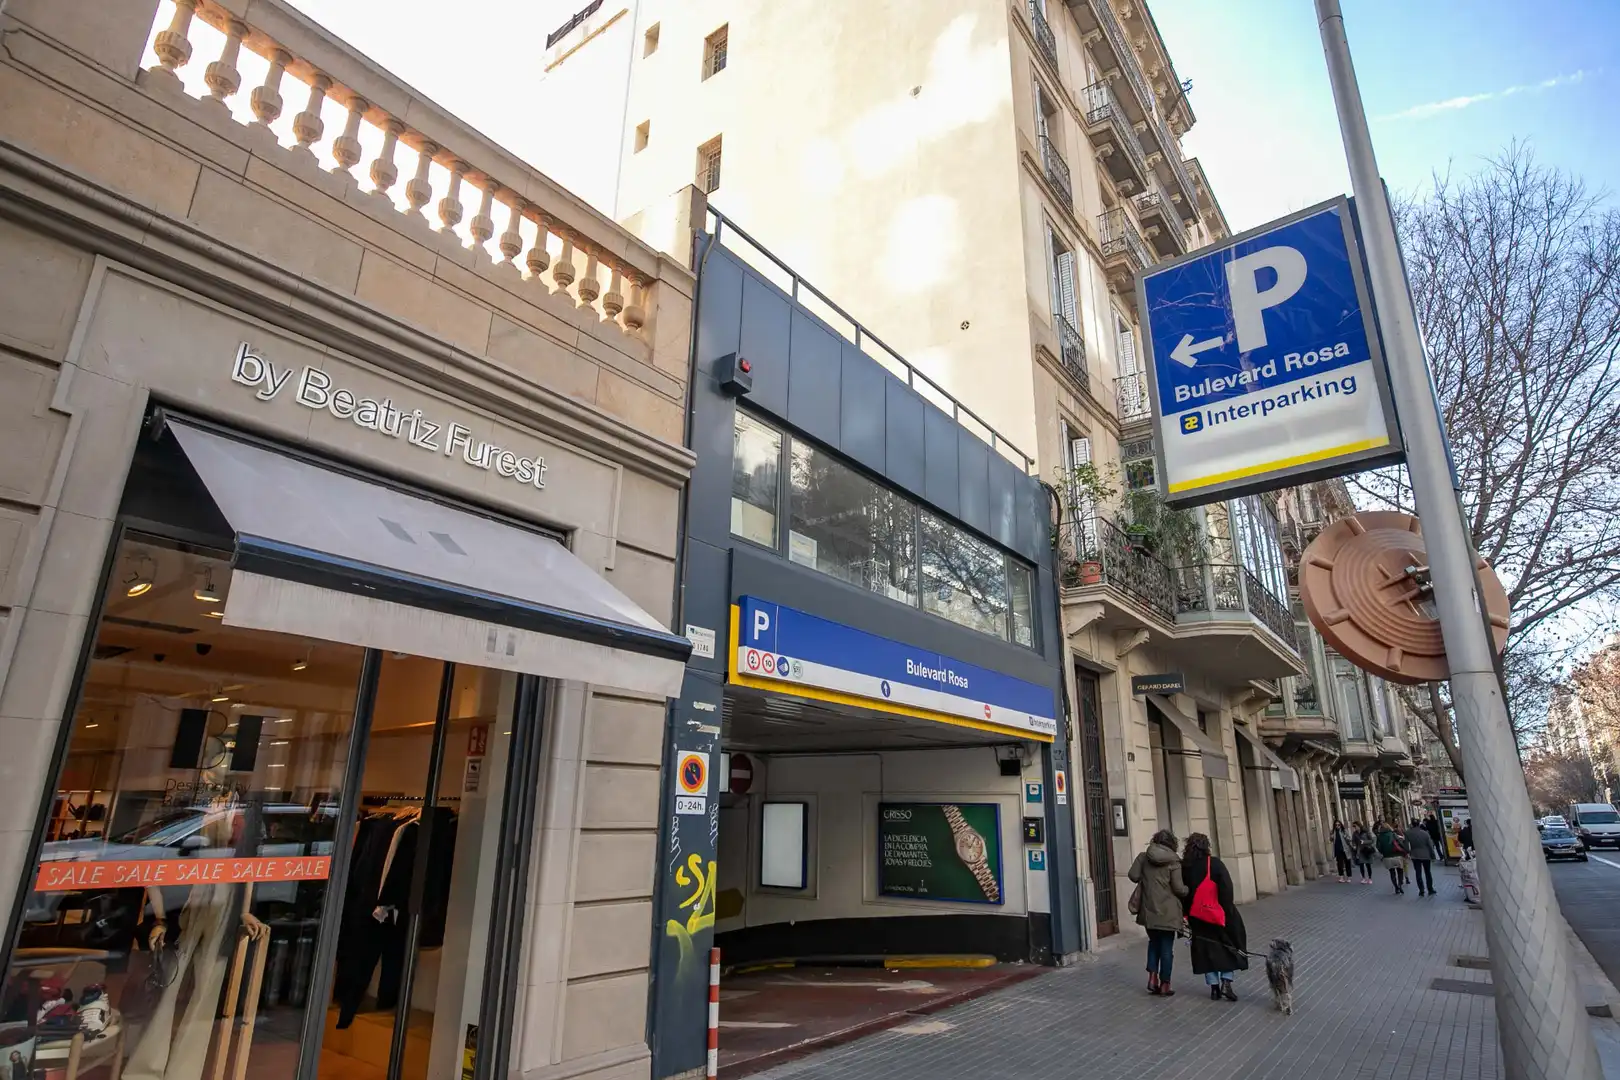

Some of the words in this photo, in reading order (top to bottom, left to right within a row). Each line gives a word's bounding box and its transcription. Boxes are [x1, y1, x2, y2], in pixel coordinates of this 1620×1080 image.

[1225, 245, 1307, 353] P
[1174, 359, 1277, 402] Bulevard
[1284, 342, 1350, 372] Rosa
[232, 341, 294, 400] by
[296, 365, 441, 451] Beatriz
[444, 422, 548, 489] Furest
[1207, 375, 1357, 427] Interparking
[753, 609, 769, 640] P
[906, 659, 947, 683] Bulevard
[948, 670, 969, 689] Rosa
[884, 858, 903, 866] JOYAS
[893, 842, 900, 850] LA
[901, 843, 928, 851] COMPRA
[48, 866, 105, 886] SALE
[113, 864, 168, 883] SALE
[176, 863, 225, 881] SALE
[232, 861, 277, 879] SALE
[284, 860, 325, 877] SALE
